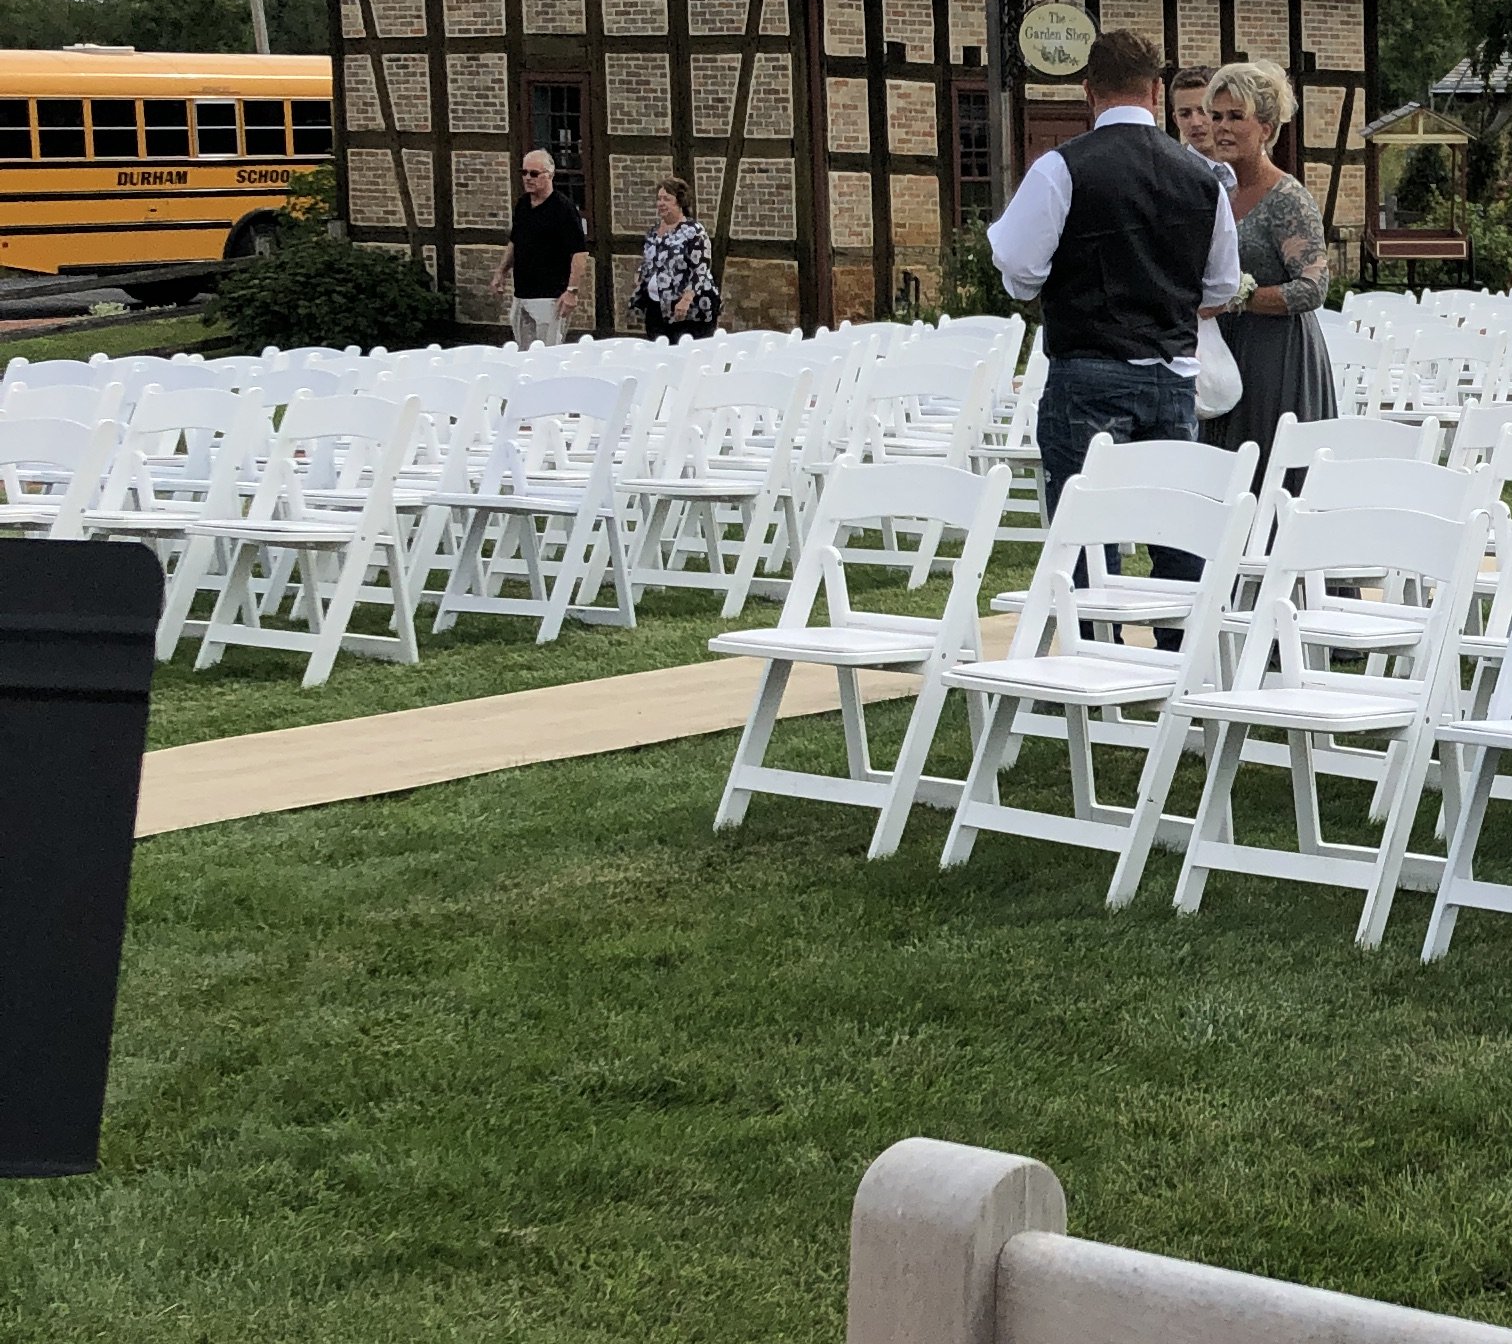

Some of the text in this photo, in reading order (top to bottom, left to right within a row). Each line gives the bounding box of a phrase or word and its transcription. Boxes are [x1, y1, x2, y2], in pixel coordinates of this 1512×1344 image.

[1048, 12, 1066, 24] The
[1025, 26, 1091, 45] Garden Shop
[117, 169, 290, 186] DURHAM SCHOO
